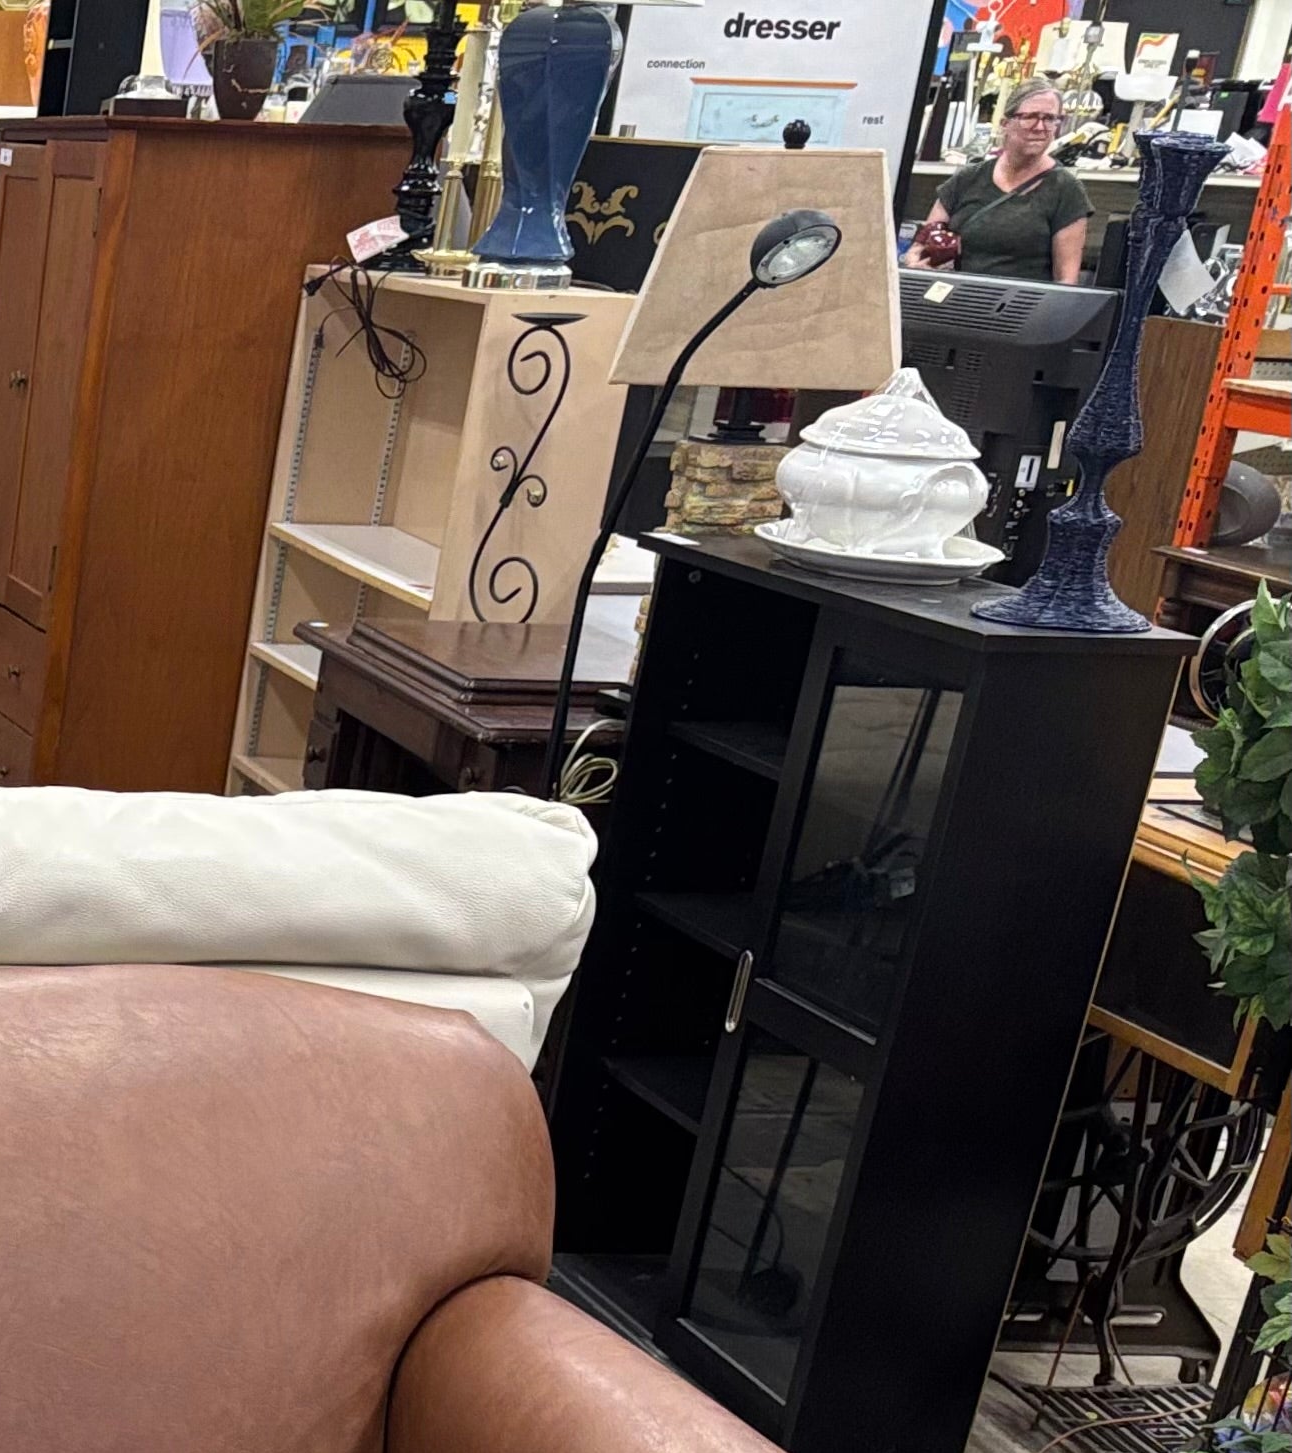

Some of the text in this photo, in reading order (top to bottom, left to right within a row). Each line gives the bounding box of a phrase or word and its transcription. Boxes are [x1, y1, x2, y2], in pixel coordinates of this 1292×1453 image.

[724, 12, 840, 40] dresser
[647, 58, 706, 70] connection
[862, 115, 884, 125] rest
